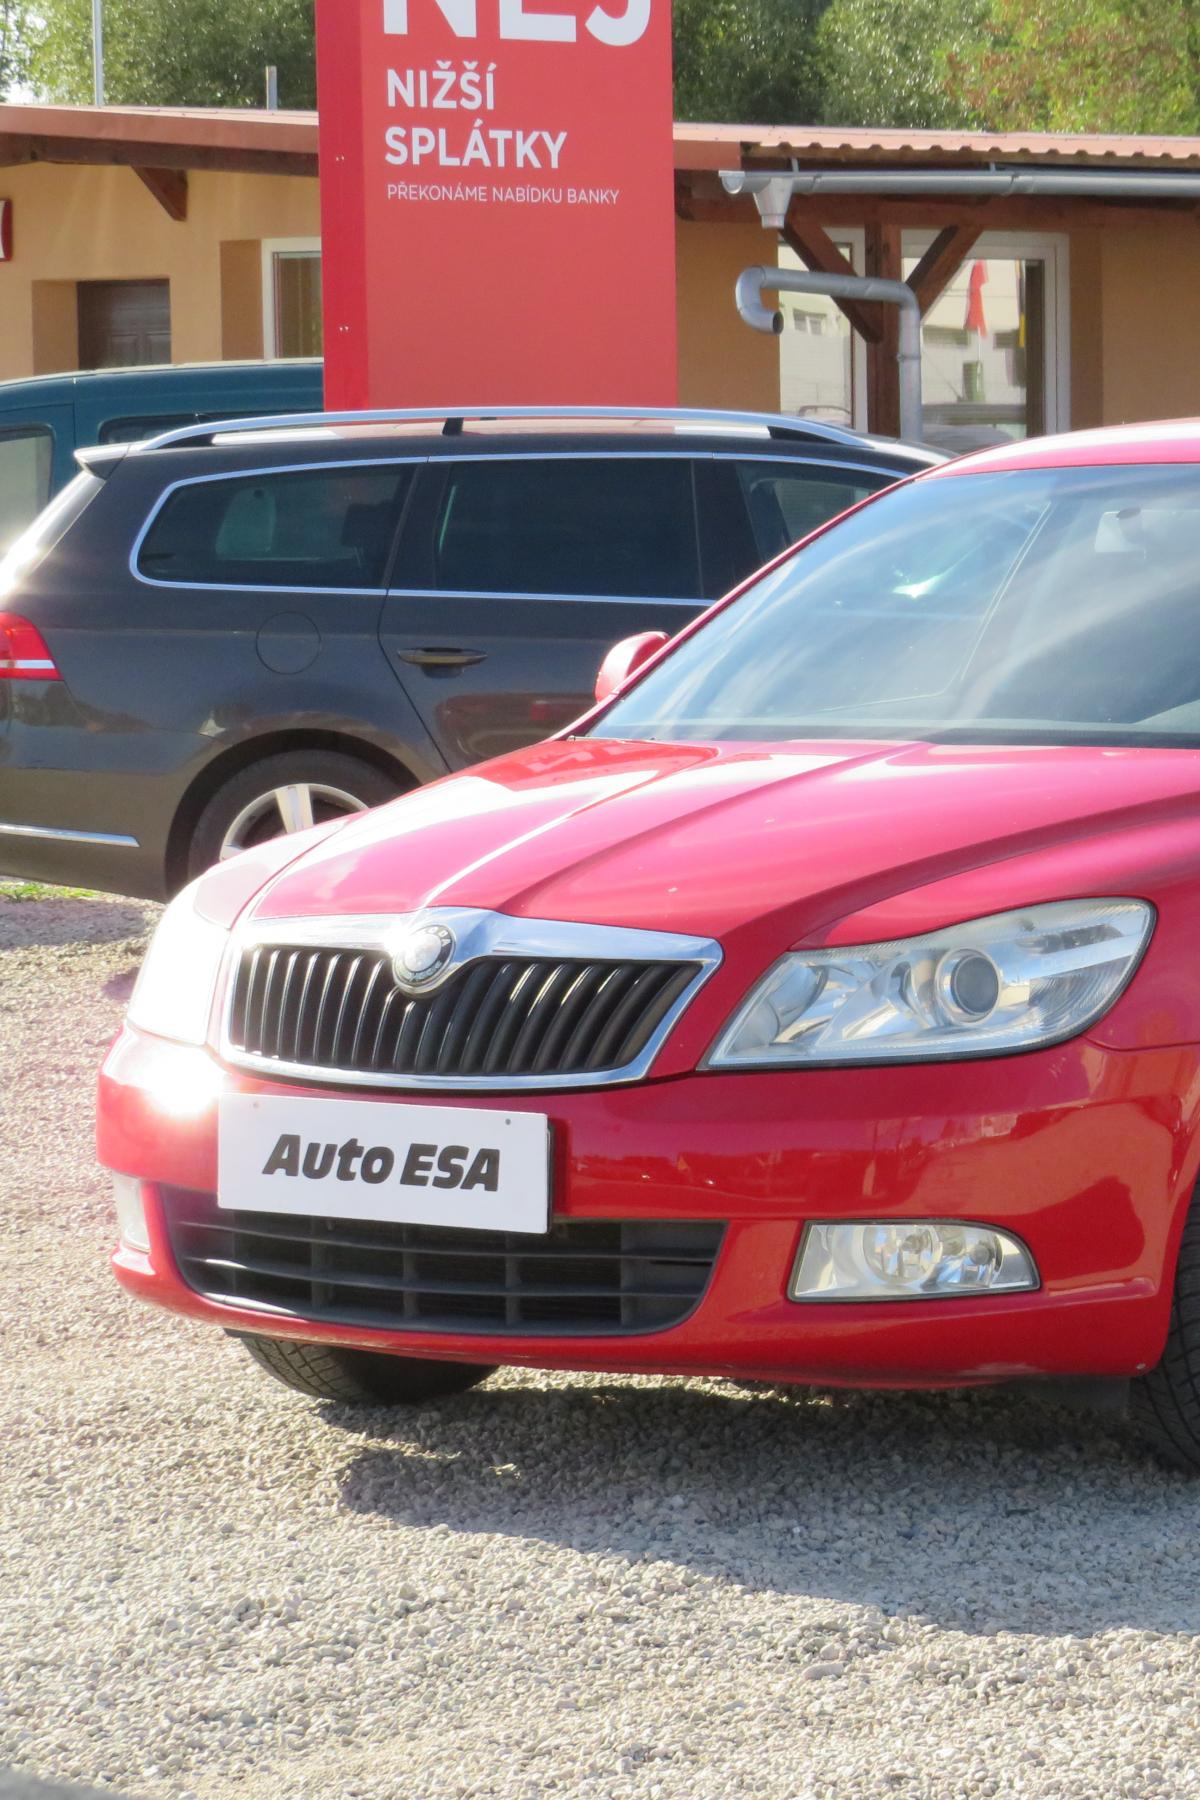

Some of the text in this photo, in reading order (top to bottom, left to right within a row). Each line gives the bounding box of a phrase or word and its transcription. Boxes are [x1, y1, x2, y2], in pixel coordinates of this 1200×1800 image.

[387, 60, 497, 110] NIŽŠÍ
[385, 118, 568, 169] SPLÁTKY
[387, 182, 620, 205] PŘEKONÁME NABÍDKU BANKY
[262, 1134, 500, 1192] Auto ESA
